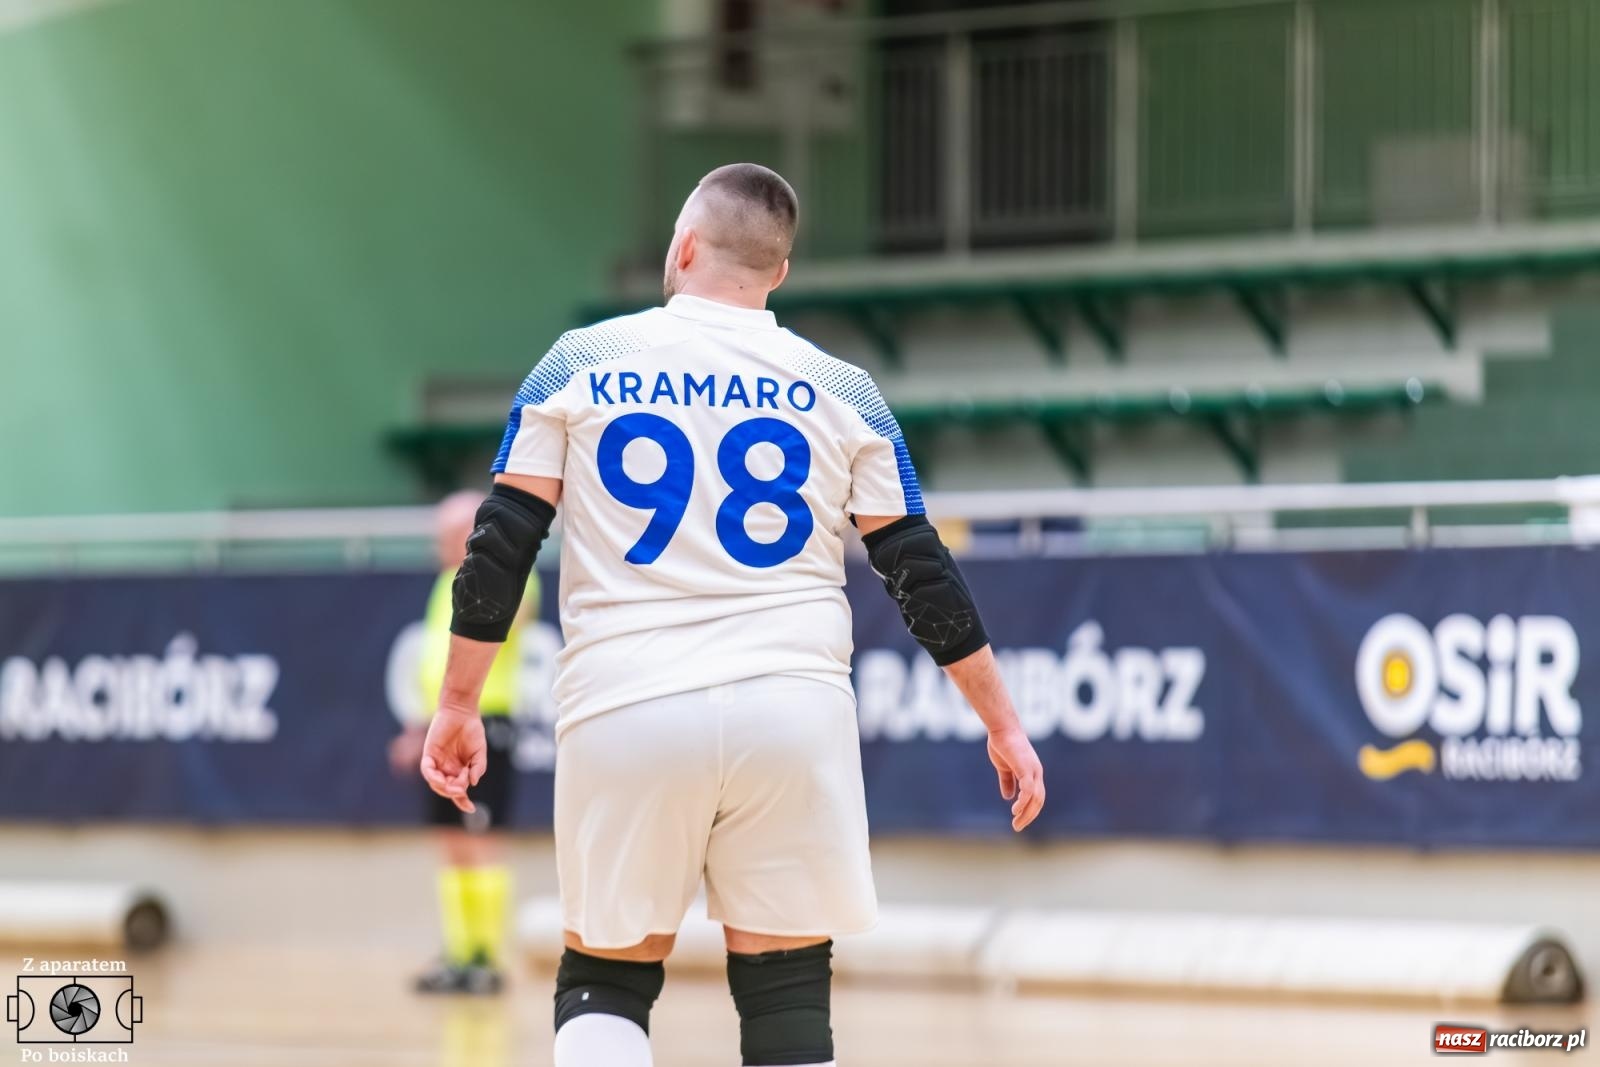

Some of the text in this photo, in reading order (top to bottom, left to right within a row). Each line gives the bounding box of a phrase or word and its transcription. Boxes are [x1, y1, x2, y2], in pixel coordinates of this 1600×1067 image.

[589, 371, 816, 412] KRAMARO
[597, 412, 814, 568] 98
[0, 631, 279, 741] RACIBÓRZ
[857, 621, 1205, 741] RAIBÓRZ
